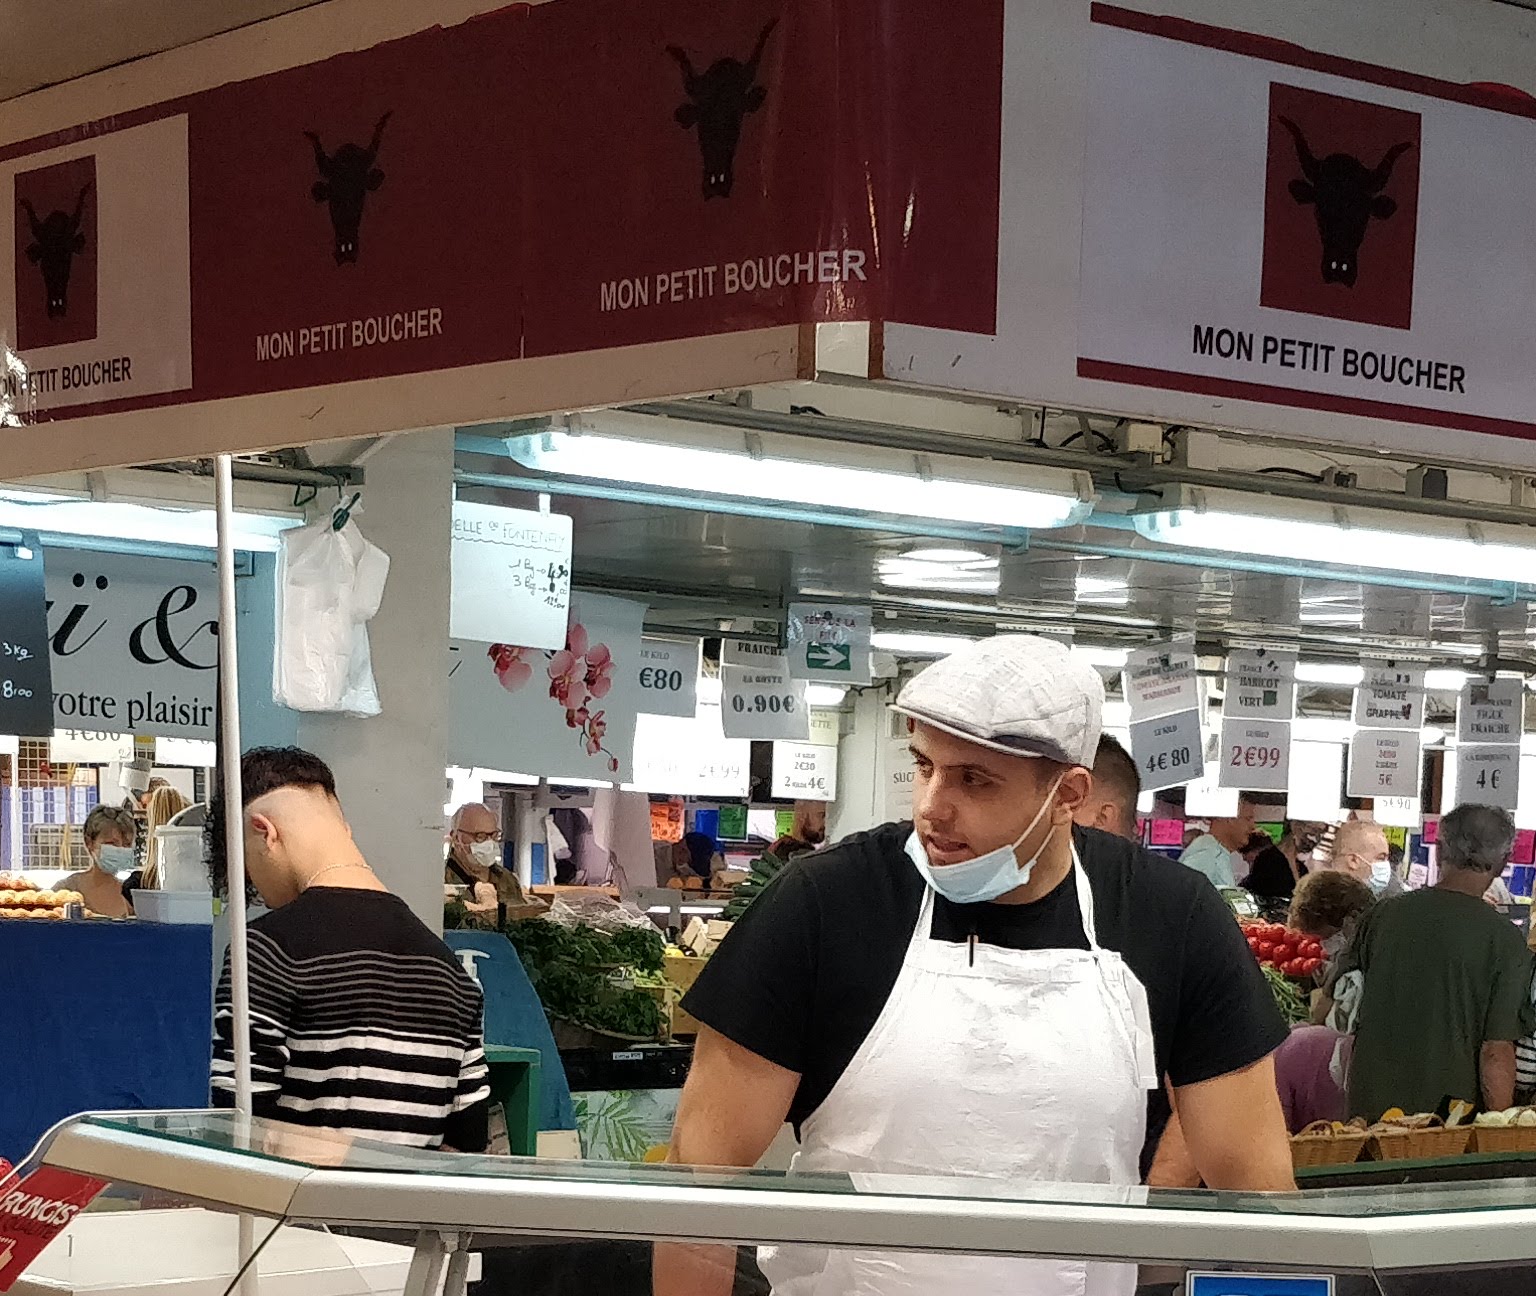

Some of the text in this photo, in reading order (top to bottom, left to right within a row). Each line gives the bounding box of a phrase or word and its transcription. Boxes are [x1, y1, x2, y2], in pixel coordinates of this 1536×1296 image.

[600, 249, 868, 312] MON PETIT BOUCHER
[257, 307, 443, 361] MON PETIT BOUCHER
[62, 356, 132, 390] BOUCHER
[1192, 324, 1466, 394] MON PETIT BOUCHER
[452, 518, 483, 535] ELLE
[129, 585, 218, 670] &
[127, 690, 213, 730] plaisir
[733, 695, 795, 714] 0.90€
[1238, 696, 1262, 707] VERT
[1172, 747, 1191, 767] 80
[1230, 745, 1281, 768] 2€99
[893, 772, 916, 783] SUC
